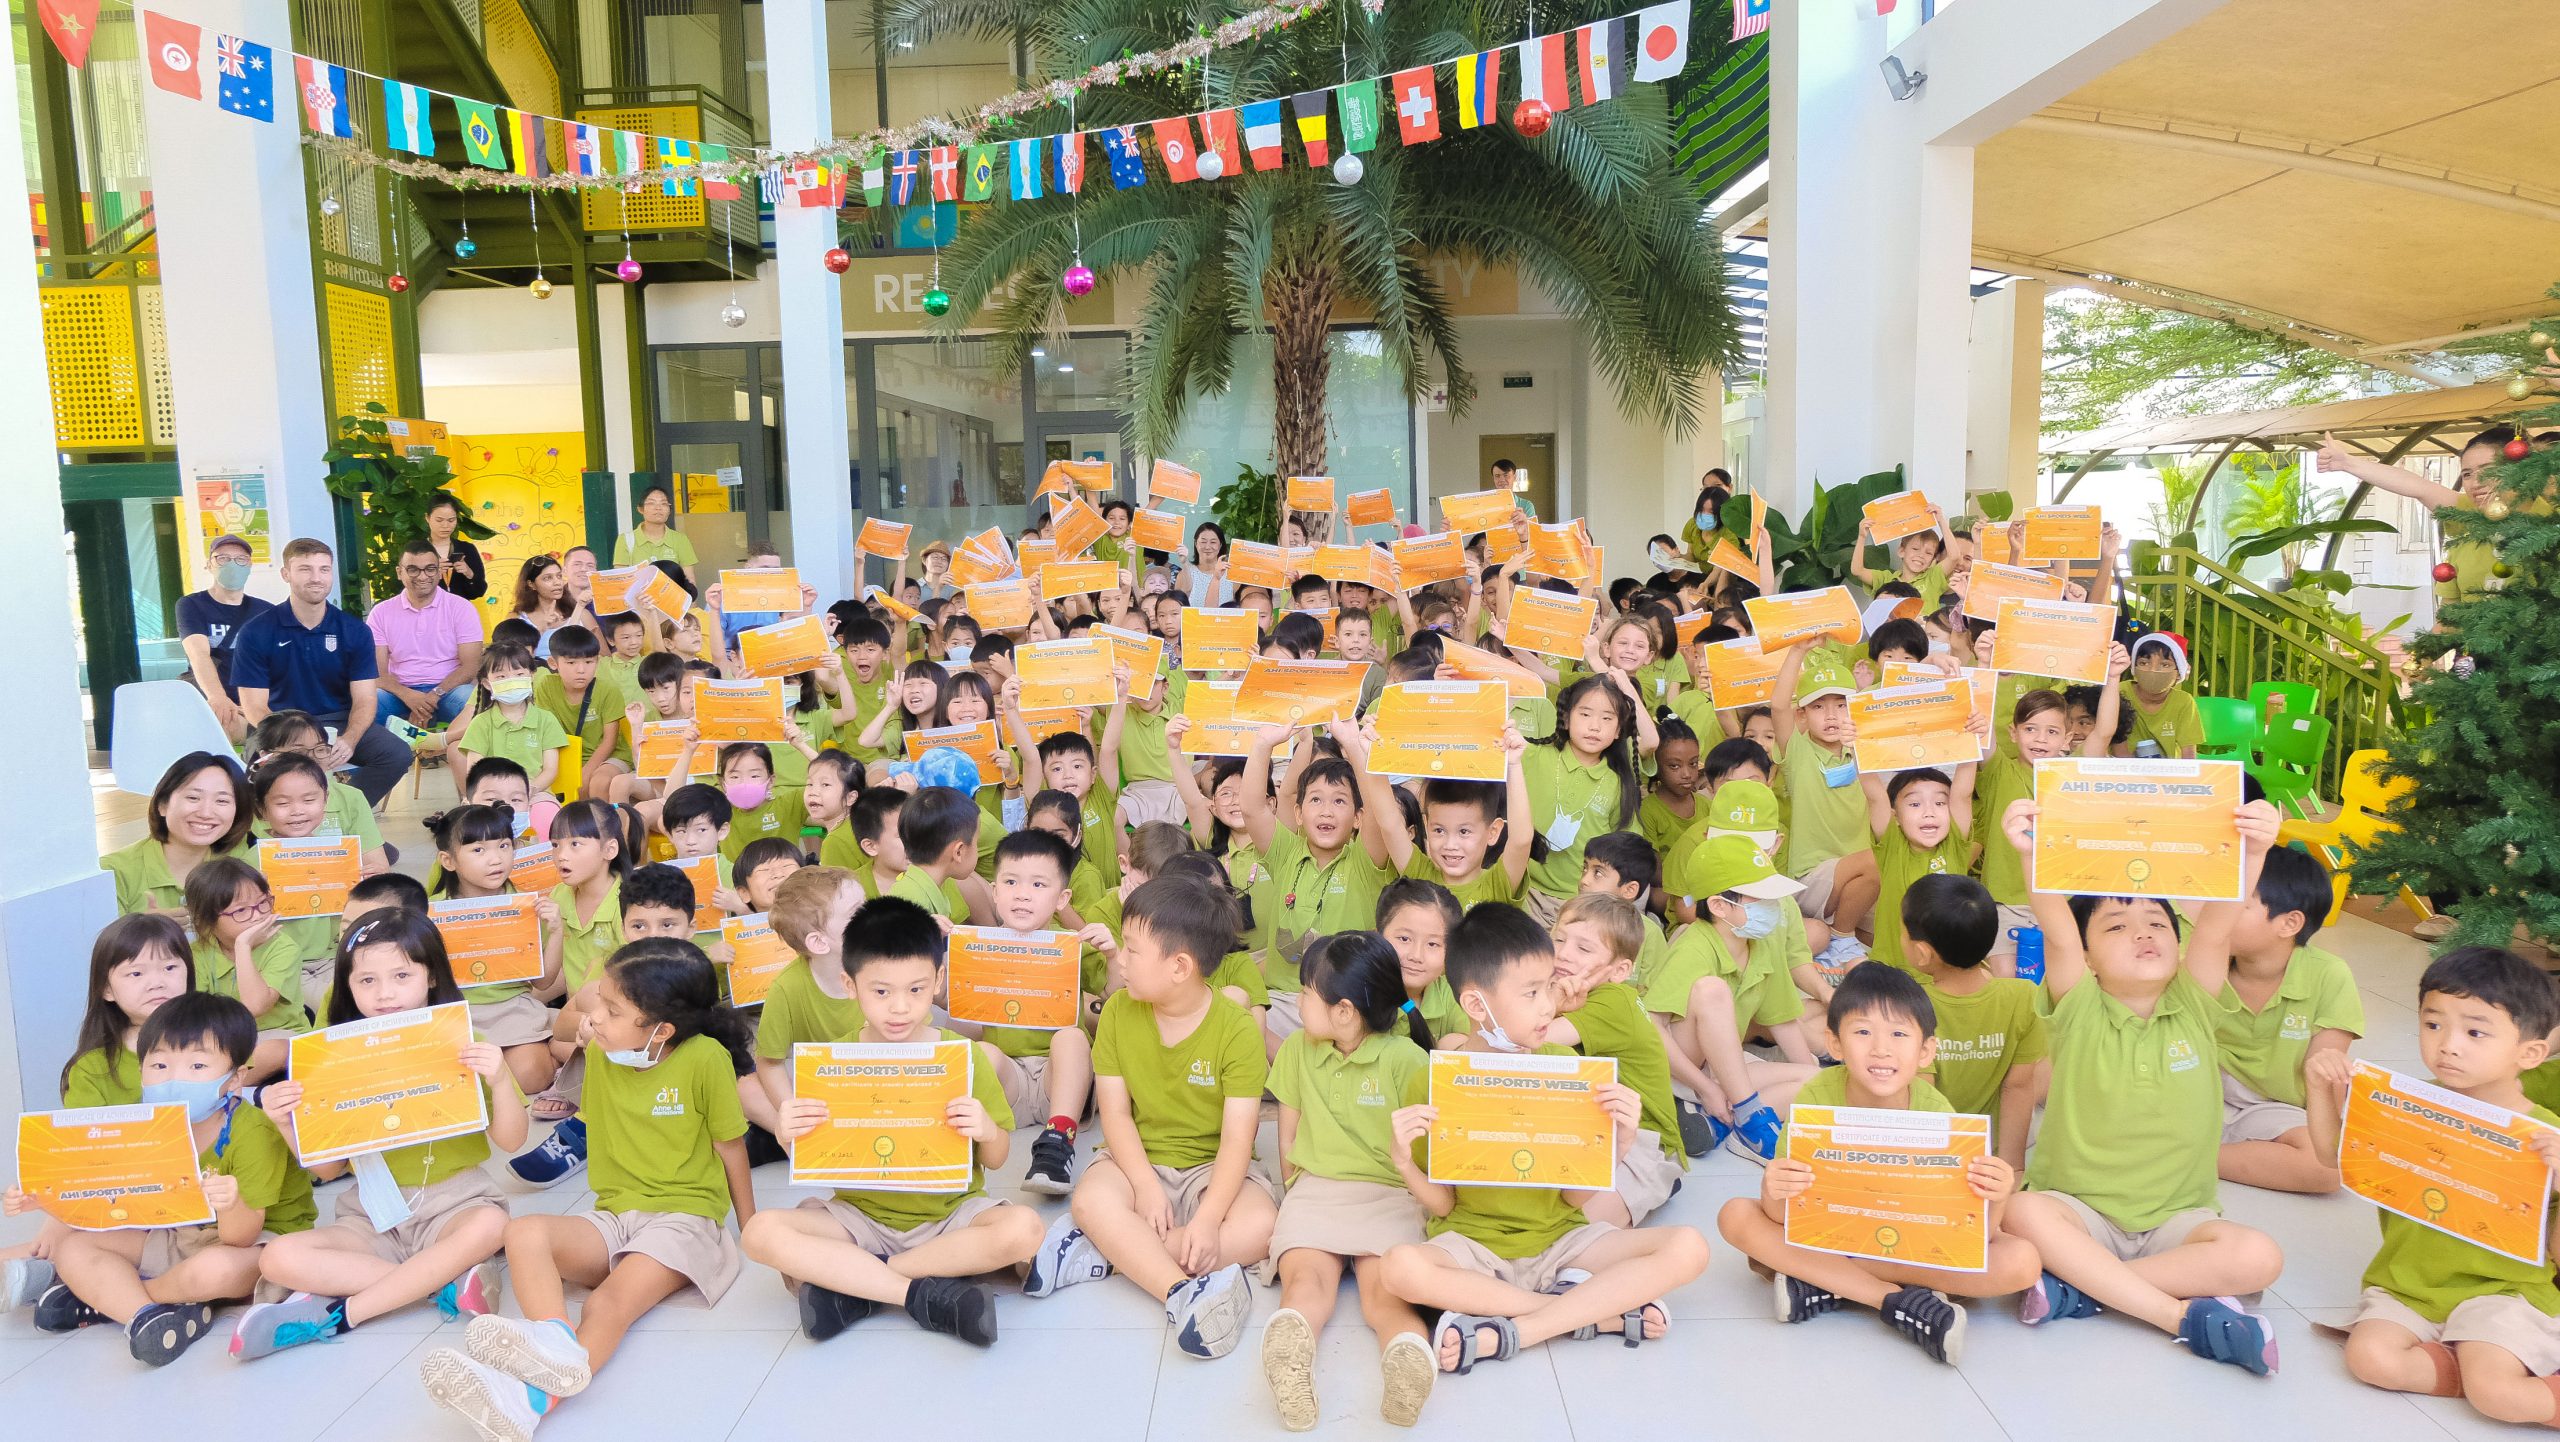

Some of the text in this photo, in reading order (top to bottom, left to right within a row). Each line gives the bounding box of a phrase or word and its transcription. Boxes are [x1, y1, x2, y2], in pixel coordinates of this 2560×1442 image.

[1999, 571, 2028, 581] SPORTS
[2029, 577, 2052, 586] WEEK
[1523, 597, 1535, 605] AHI
[1536, 599, 1562, 609] SPORTS
[2012, 609, 2099, 624] AHI SPORTS WEEK
[1112, 638, 1151, 652] ORTS WEEK
[1044, 650, 1075, 658] SPORTS
[1865, 695, 1954, 712] AHI SPORTS WEEK
[1218, 724, 1246, 732] SPORTS
[917, 734, 984, 747] AHI SPORTS WEEK
[2061, 781, 2213, 796] AHI SPORTS WEEK
[445, 912, 487, 924] SPORTS
[489, 908, 520, 918] WEEK
[736, 928, 774, 940] AHI SPO
[965, 943, 1063, 957] AHI SPORTS WEEK
[2016, 966, 2036, 976] ASA
[1935, 1033, 2005, 1051] Anne Hill
[816, 1064, 947, 1076] AHI SPORTS WEEK
[1454, 1075, 1591, 1091] AHI SPORTS WEEK
[335, 1083, 441, 1111] AHI SPORTS WEEK
[2371, 1090, 2523, 1152] AHI SPORTS WEEK
[1835, 1132, 1880, 1142] CERTIFICATE
[1814, 1149, 1962, 1168] AHI SPORTS WEEK
[60, 1184, 164, 1200] AHI SPORTS WEEK
